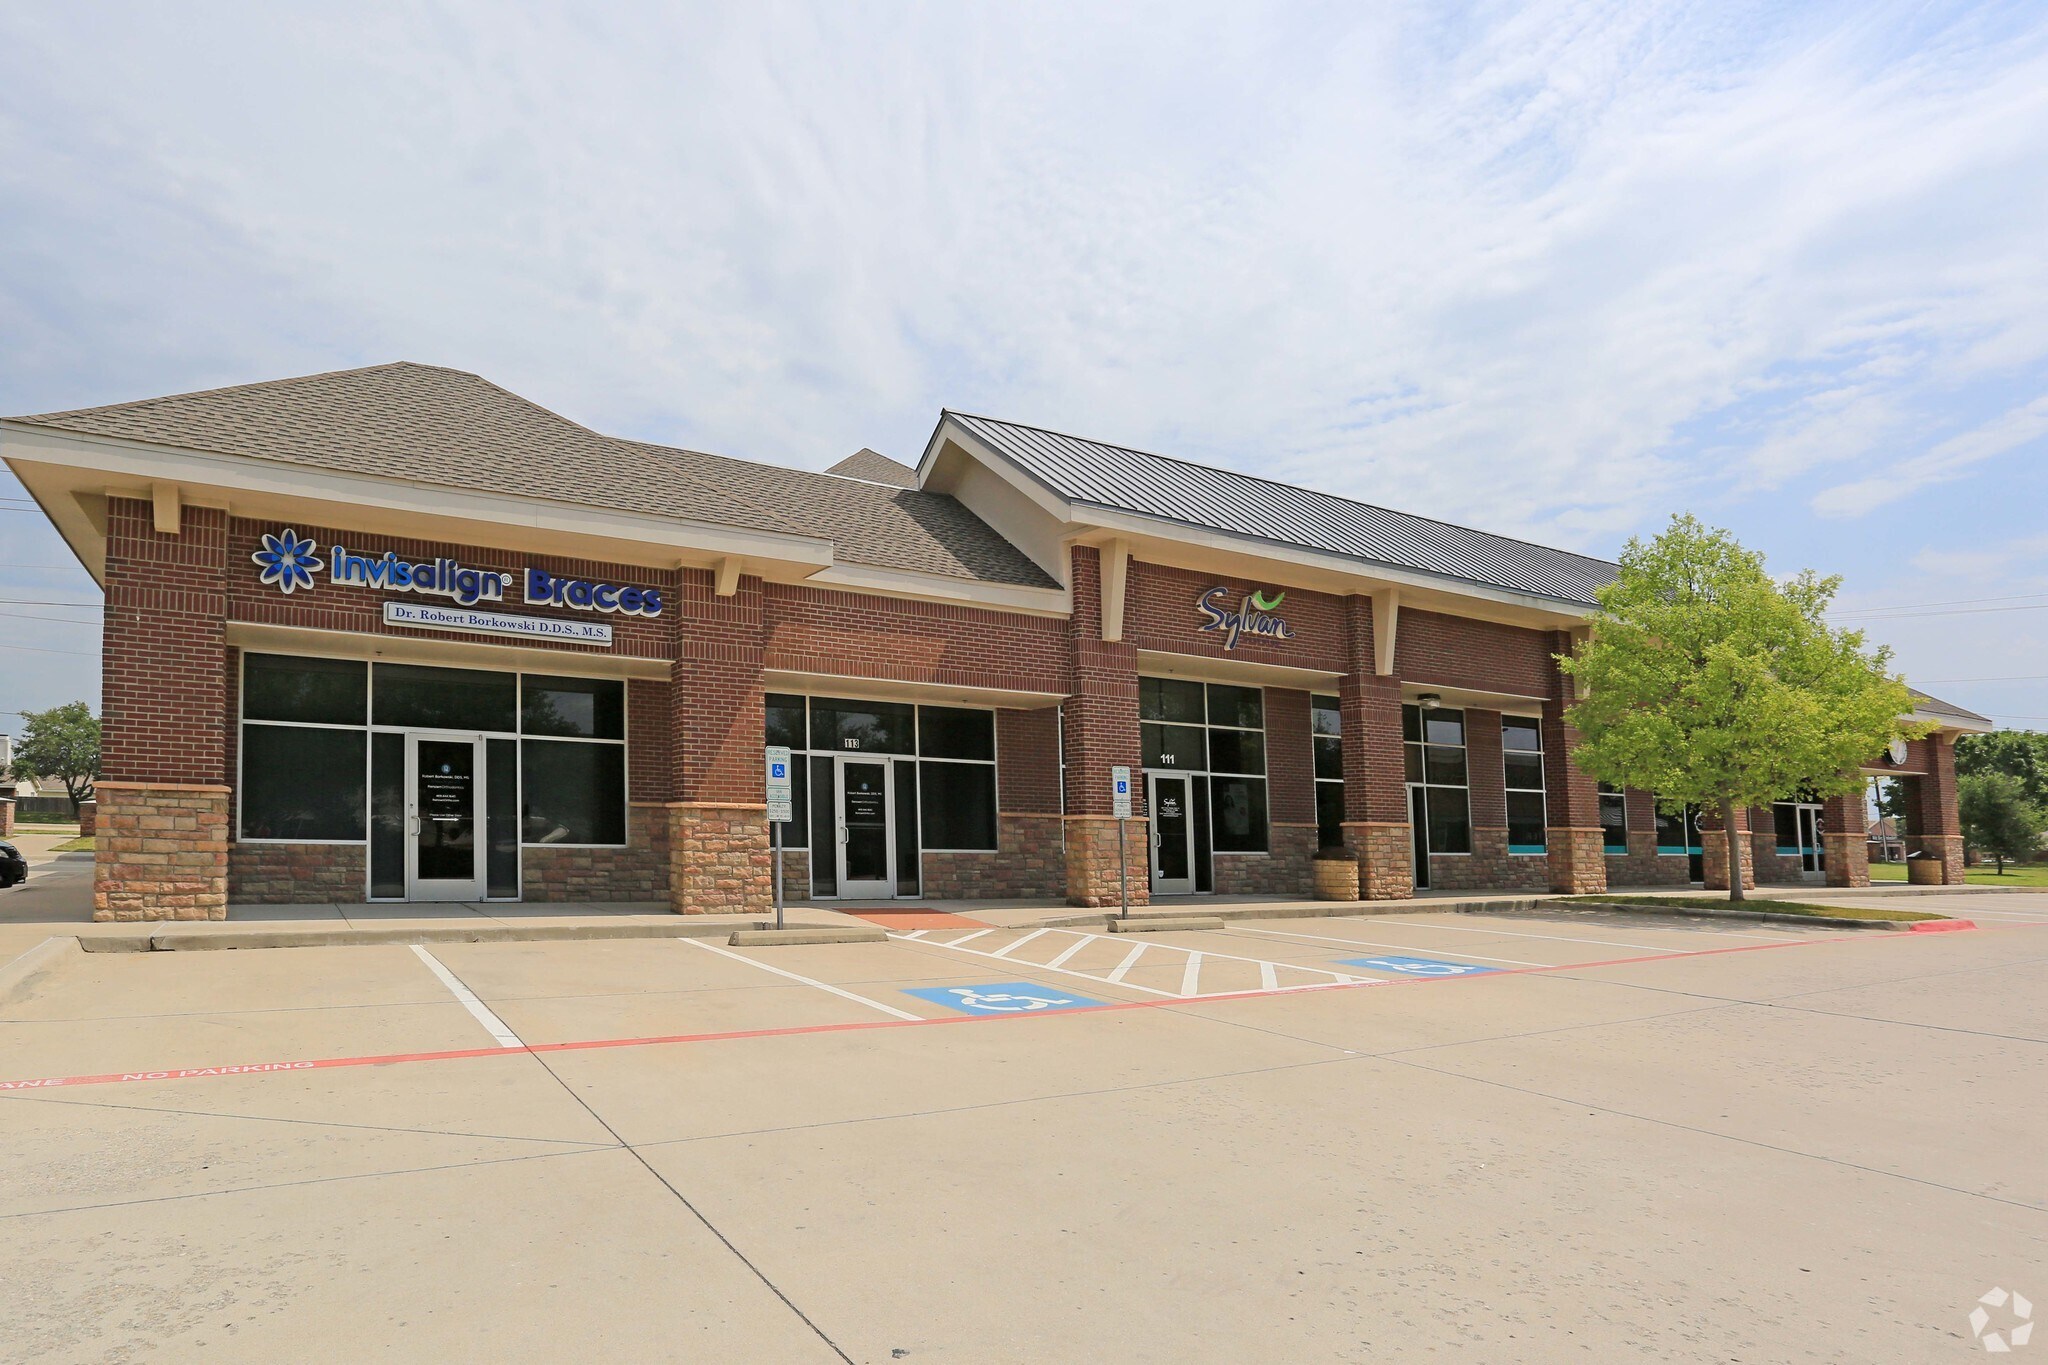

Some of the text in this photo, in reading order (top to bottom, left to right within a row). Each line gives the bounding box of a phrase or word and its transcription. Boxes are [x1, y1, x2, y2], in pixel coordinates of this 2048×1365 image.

[526, 568, 664, 616] Braces
[395, 607, 416, 619] Dr.
[420, 610, 464, 624] Robert
[468, 615, 536, 631] Borkowski
[582, 626, 607, 638] M.S.
[1197, 587, 1296, 650] Sylvan
[845, 739, 859, 748] 113
[1160, 754, 1175, 764] 111
[122, 1072, 169, 1081] NO
[180, 1062, 315, 1077] PARKING
